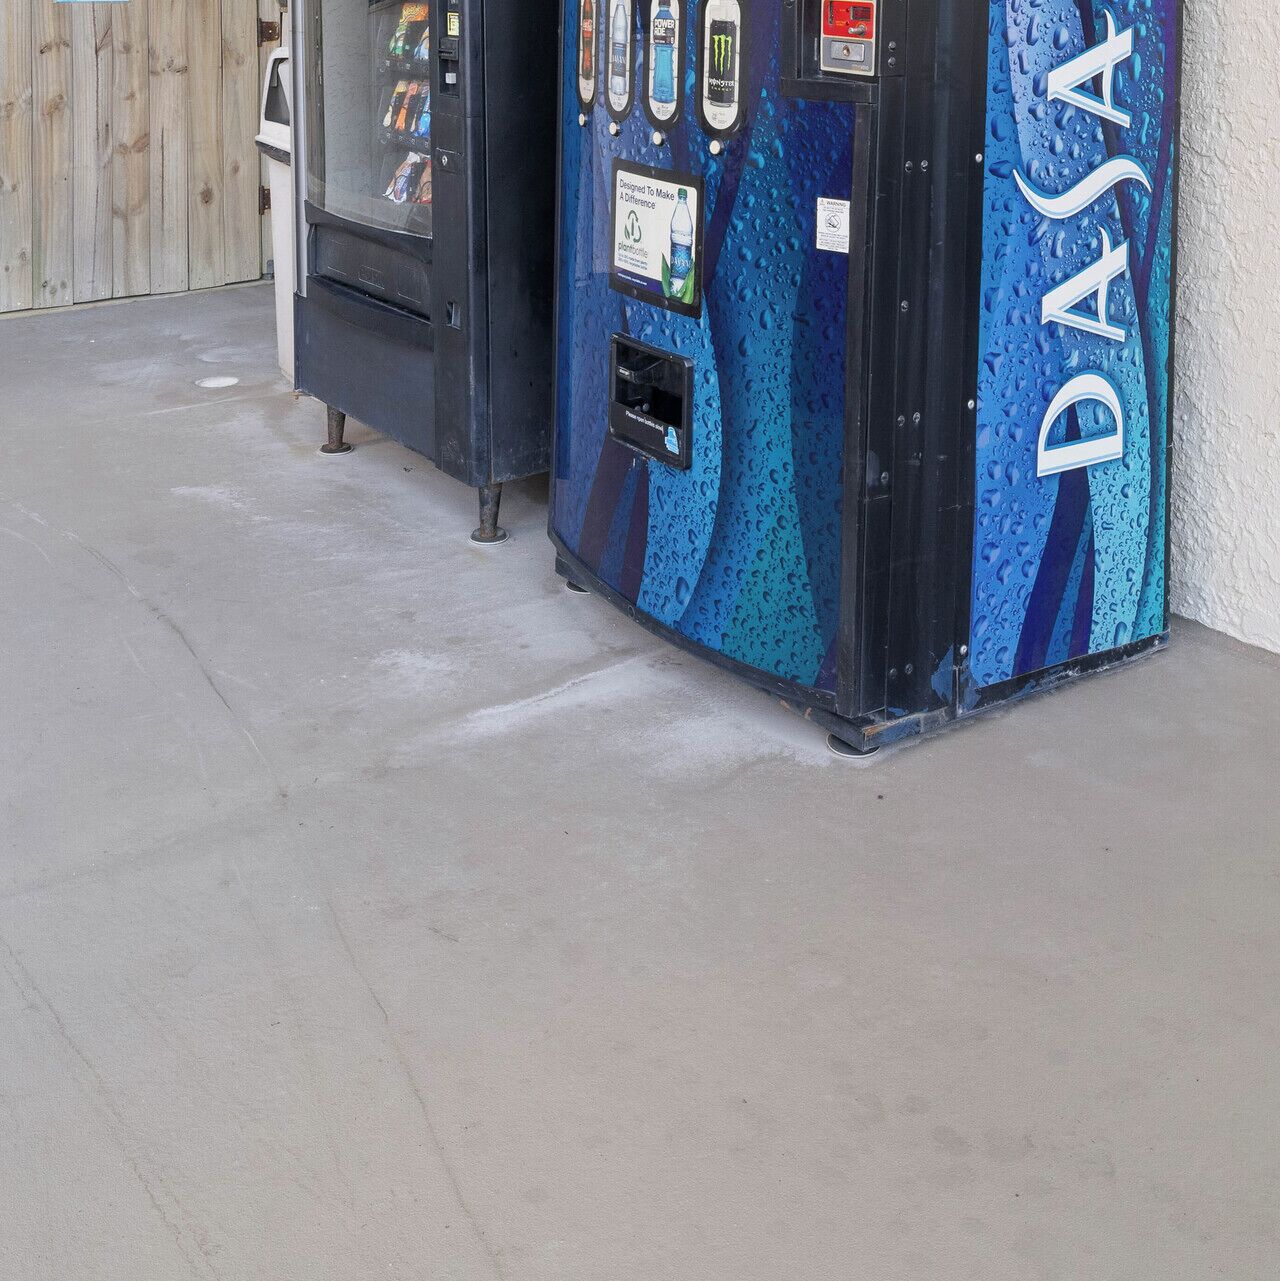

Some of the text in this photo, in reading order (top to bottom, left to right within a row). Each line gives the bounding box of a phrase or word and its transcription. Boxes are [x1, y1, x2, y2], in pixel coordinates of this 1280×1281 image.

[654, 18, 675, 28] POWER
[620, 179, 675, 201] Designed To Make
[619, 192, 656, 210] A Difference
